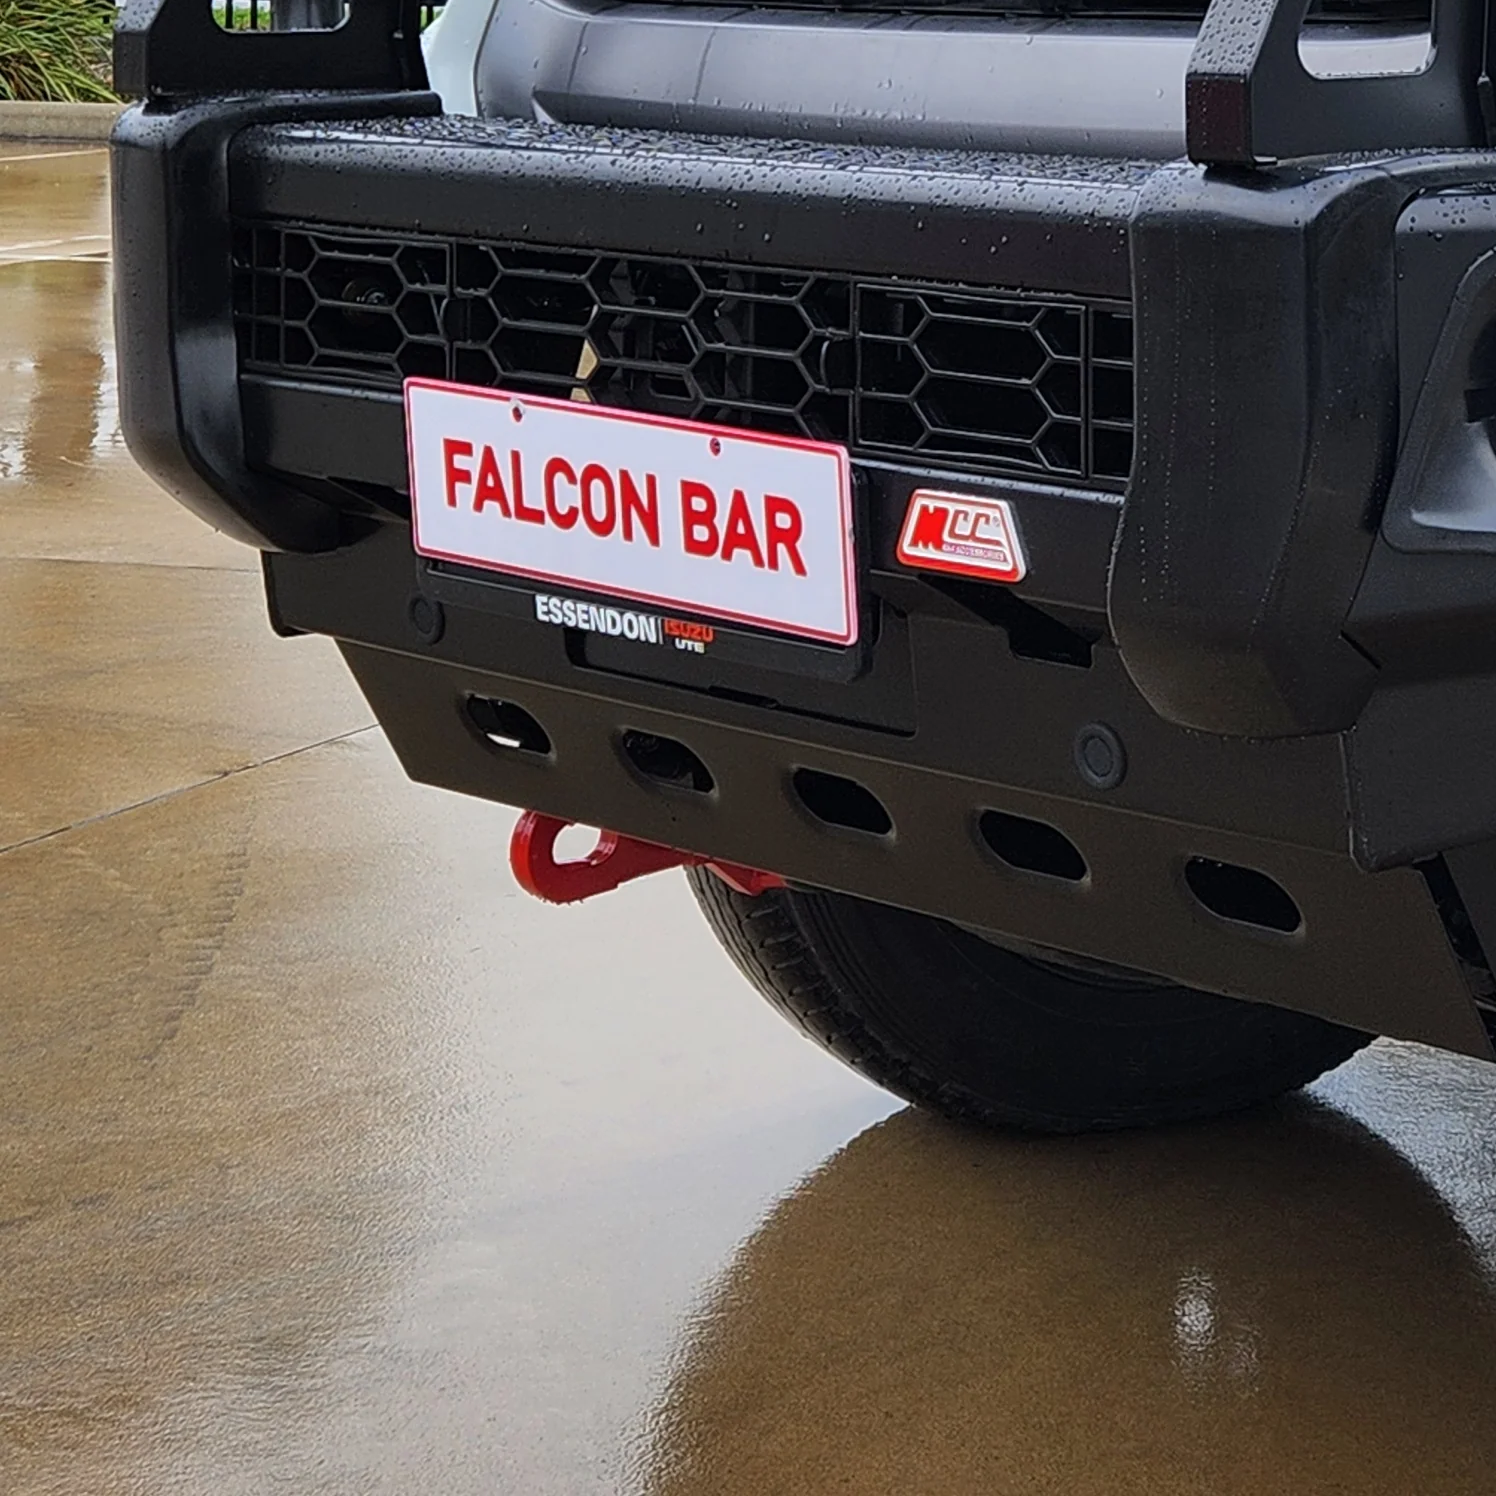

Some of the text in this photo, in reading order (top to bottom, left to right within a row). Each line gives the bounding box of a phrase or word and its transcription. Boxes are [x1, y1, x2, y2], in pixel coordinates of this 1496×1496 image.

[442, 437, 808, 578] FALCON BAR
[535, 593, 658, 644] ESSENDON
[664, 619, 714, 643] ISUZU
[674, 637, 705, 654] UTE
